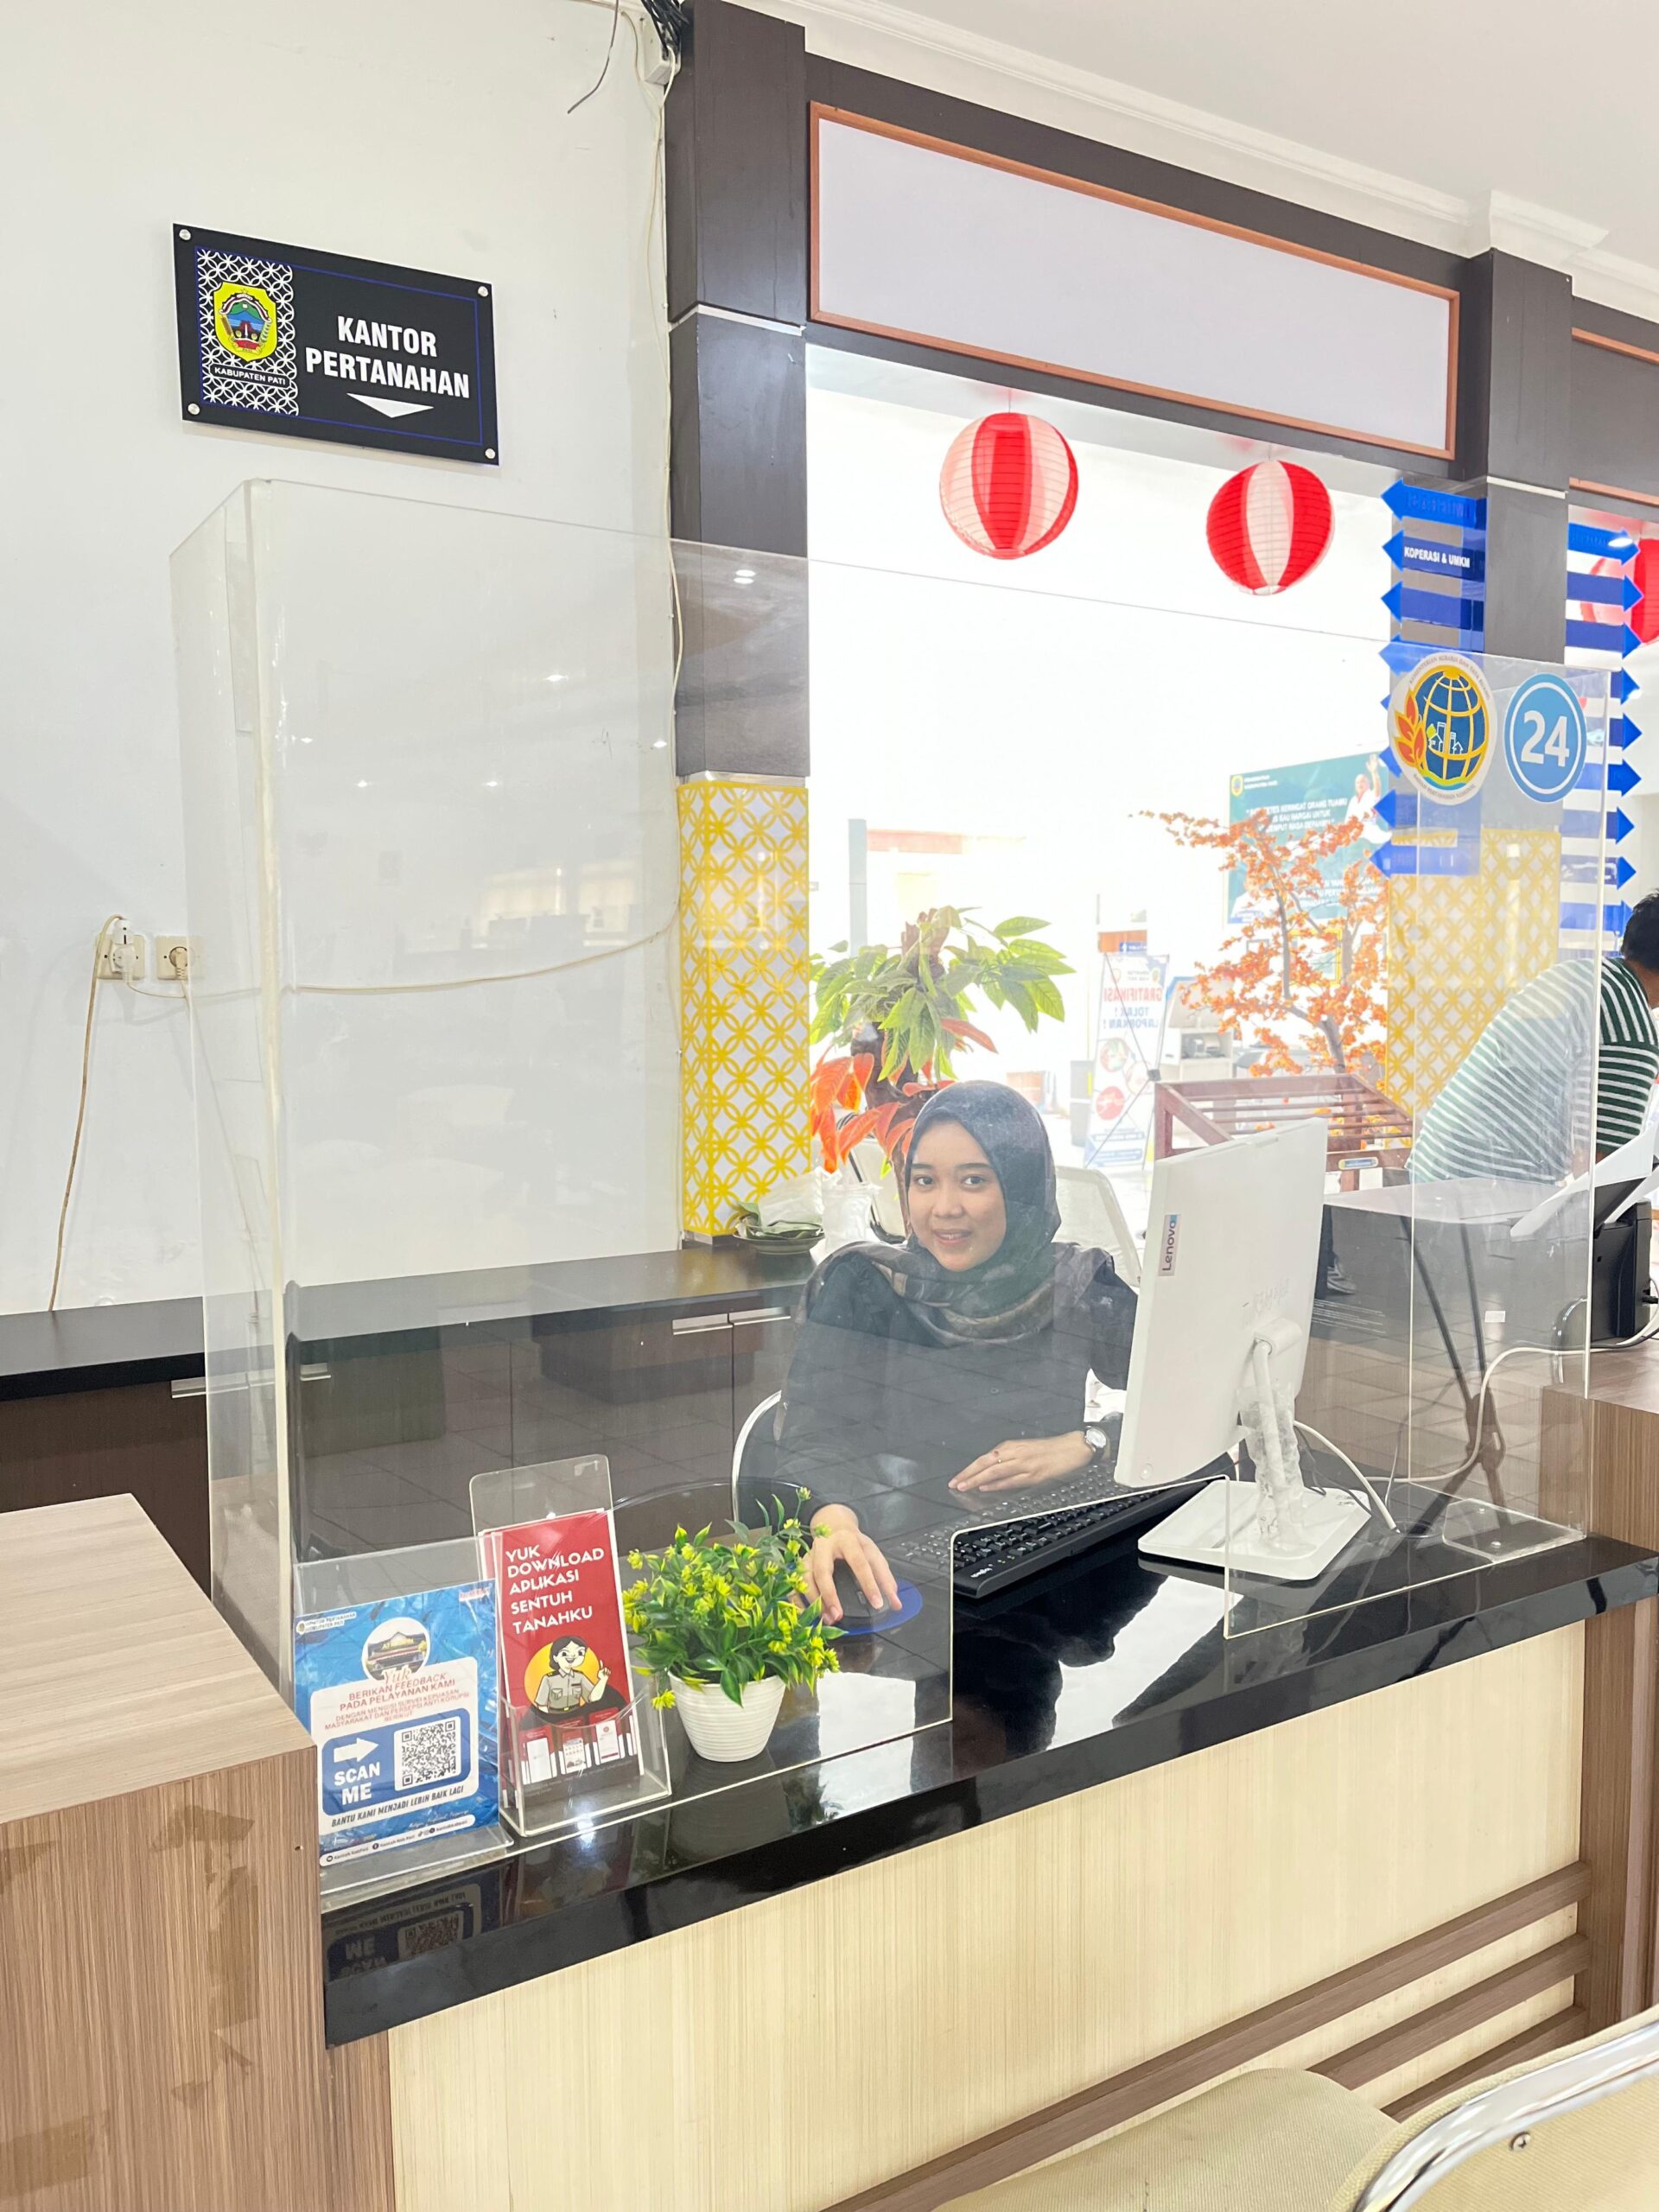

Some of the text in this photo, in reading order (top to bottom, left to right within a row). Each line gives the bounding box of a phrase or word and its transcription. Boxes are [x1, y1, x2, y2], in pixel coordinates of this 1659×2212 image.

[338, 315, 437, 357] KANTOR
[214, 366, 286, 386] KABUPATEN PATI
[306, 347, 470, 398] PERTANAHAN
[1404, 546, 1471, 569] KOPERASI & UMKM
[1521, 710, 1570, 767] 24
[1162, 1220, 1177, 1271] Lenovo
[505, 1544, 540, 1562] YUK
[508, 1548, 605, 1579] DOWNLOAD
[510, 1569, 579, 1595] APLIKASI
[511, 1592, 573, 1615] SENTUH
[513, 1606, 594, 1635] TANAHKU
[349, 1673, 447, 1700] BERIKAN FEEDBACK
[385, 1667, 410, 1684] Yuk
[336, 1711, 366, 1722] DENGAN
[423, 1689, 460, 1701] KEPUASAN
[340, 1679, 455, 1711] PADA PELAYANAN KAMI
[325, 1716, 372, 1730] MASYARAKAT
[374, 1711, 389, 1719] DAN
[423, 1700, 441, 1708] ANTI
[334, 1762, 381, 1786] SCAN
[332, 1785, 464, 1827] BANTU KAMI MENJADI LEBIH BAIK LAGI
[341, 1783, 372, 1805] ME
